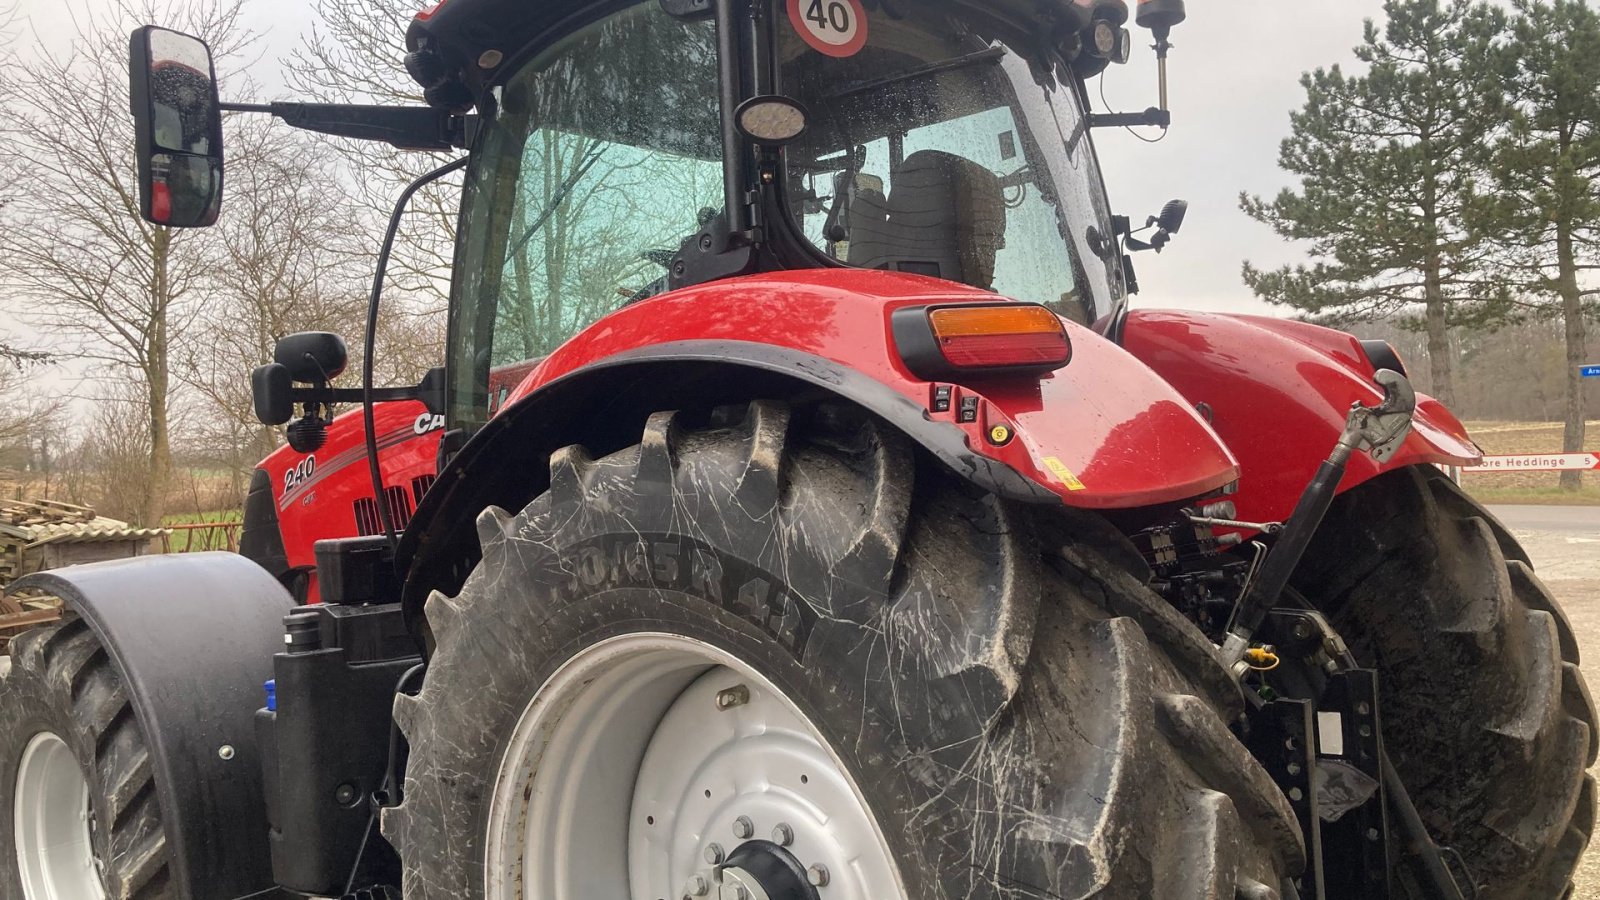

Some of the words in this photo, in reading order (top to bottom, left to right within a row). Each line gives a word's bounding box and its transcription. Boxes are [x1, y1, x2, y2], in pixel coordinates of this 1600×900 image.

[806, 0, 849, 33] 40
[414, 413, 445, 434] CA
[284, 454, 316, 494] 240
[1506, 458, 1565, 467] Heddinge
[1584, 457, 1591, 465] 5
